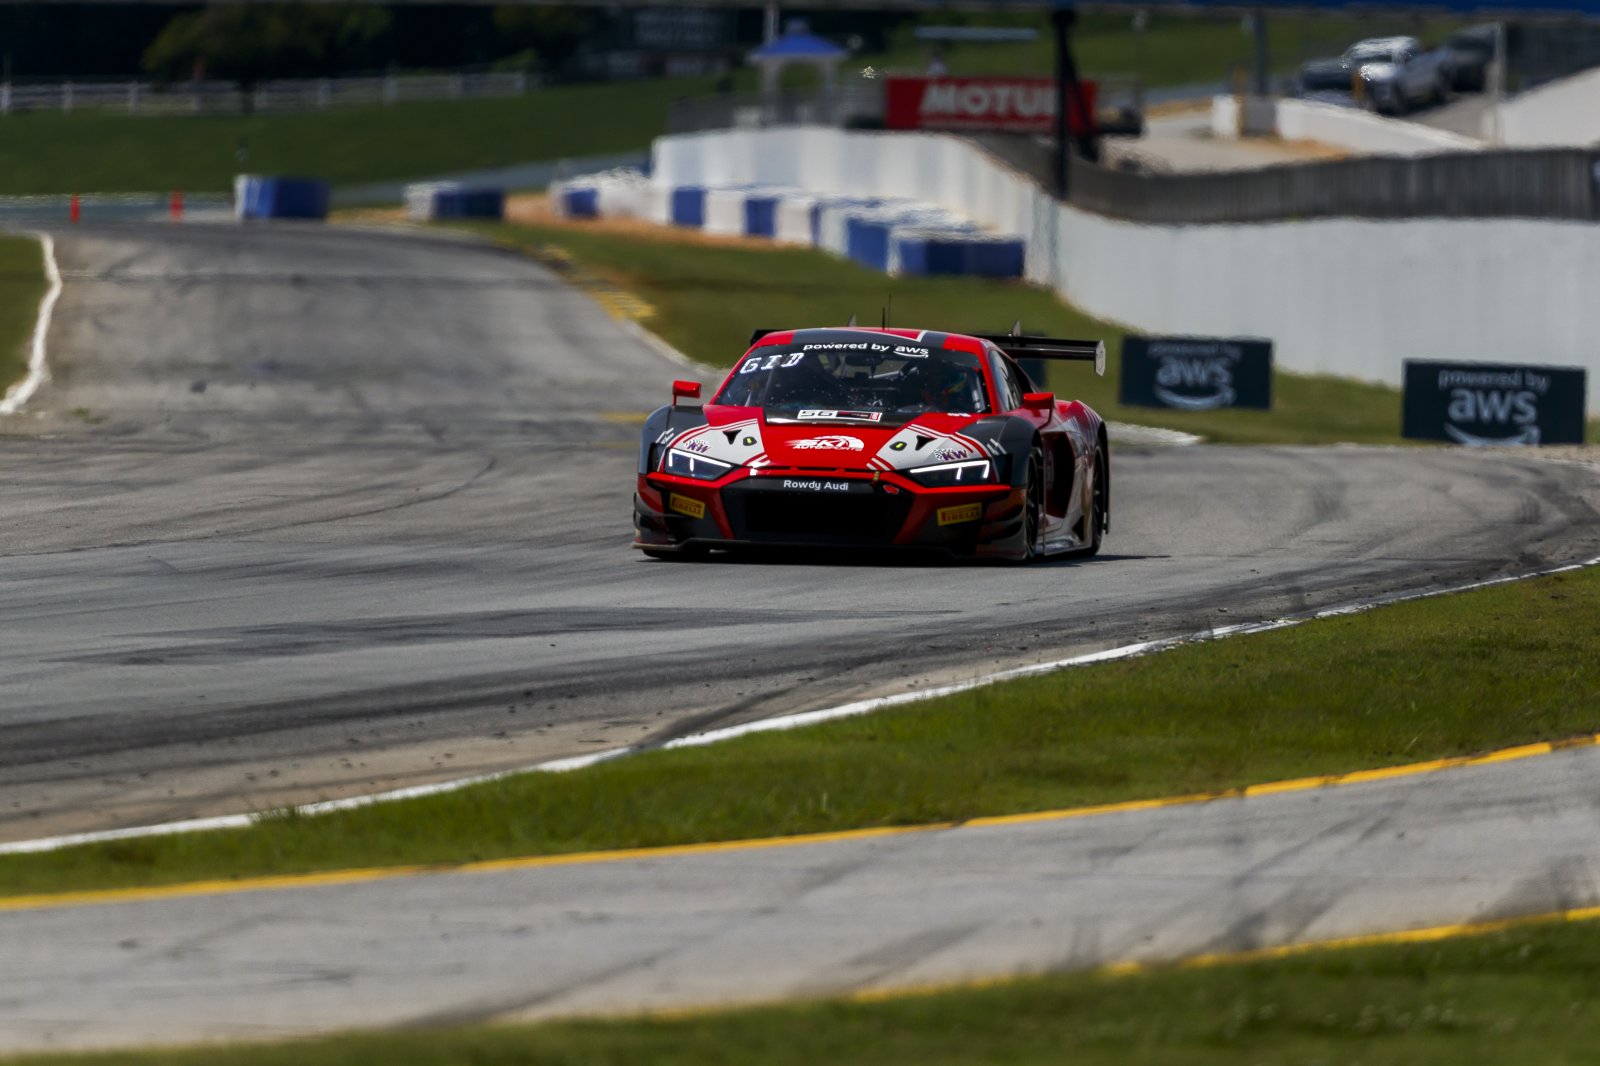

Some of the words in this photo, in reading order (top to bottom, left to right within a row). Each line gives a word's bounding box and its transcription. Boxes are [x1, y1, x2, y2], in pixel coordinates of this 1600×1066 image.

[803, 342, 866, 351] powered
[871, 343, 889, 352] by
[894, 345, 929, 356] aws
[739, 352, 805, 374] GID
[1156, 356, 1232, 387] aws
[1438, 369, 1522, 390] powered
[1525, 371, 1549, 395] by
[1448, 388, 1537, 424] aws
[686, 442, 709, 453] KW
[941, 449, 968, 460] KW
[783, 480, 821, 491] Rowdy
[824, 482, 849, 491] Audi
